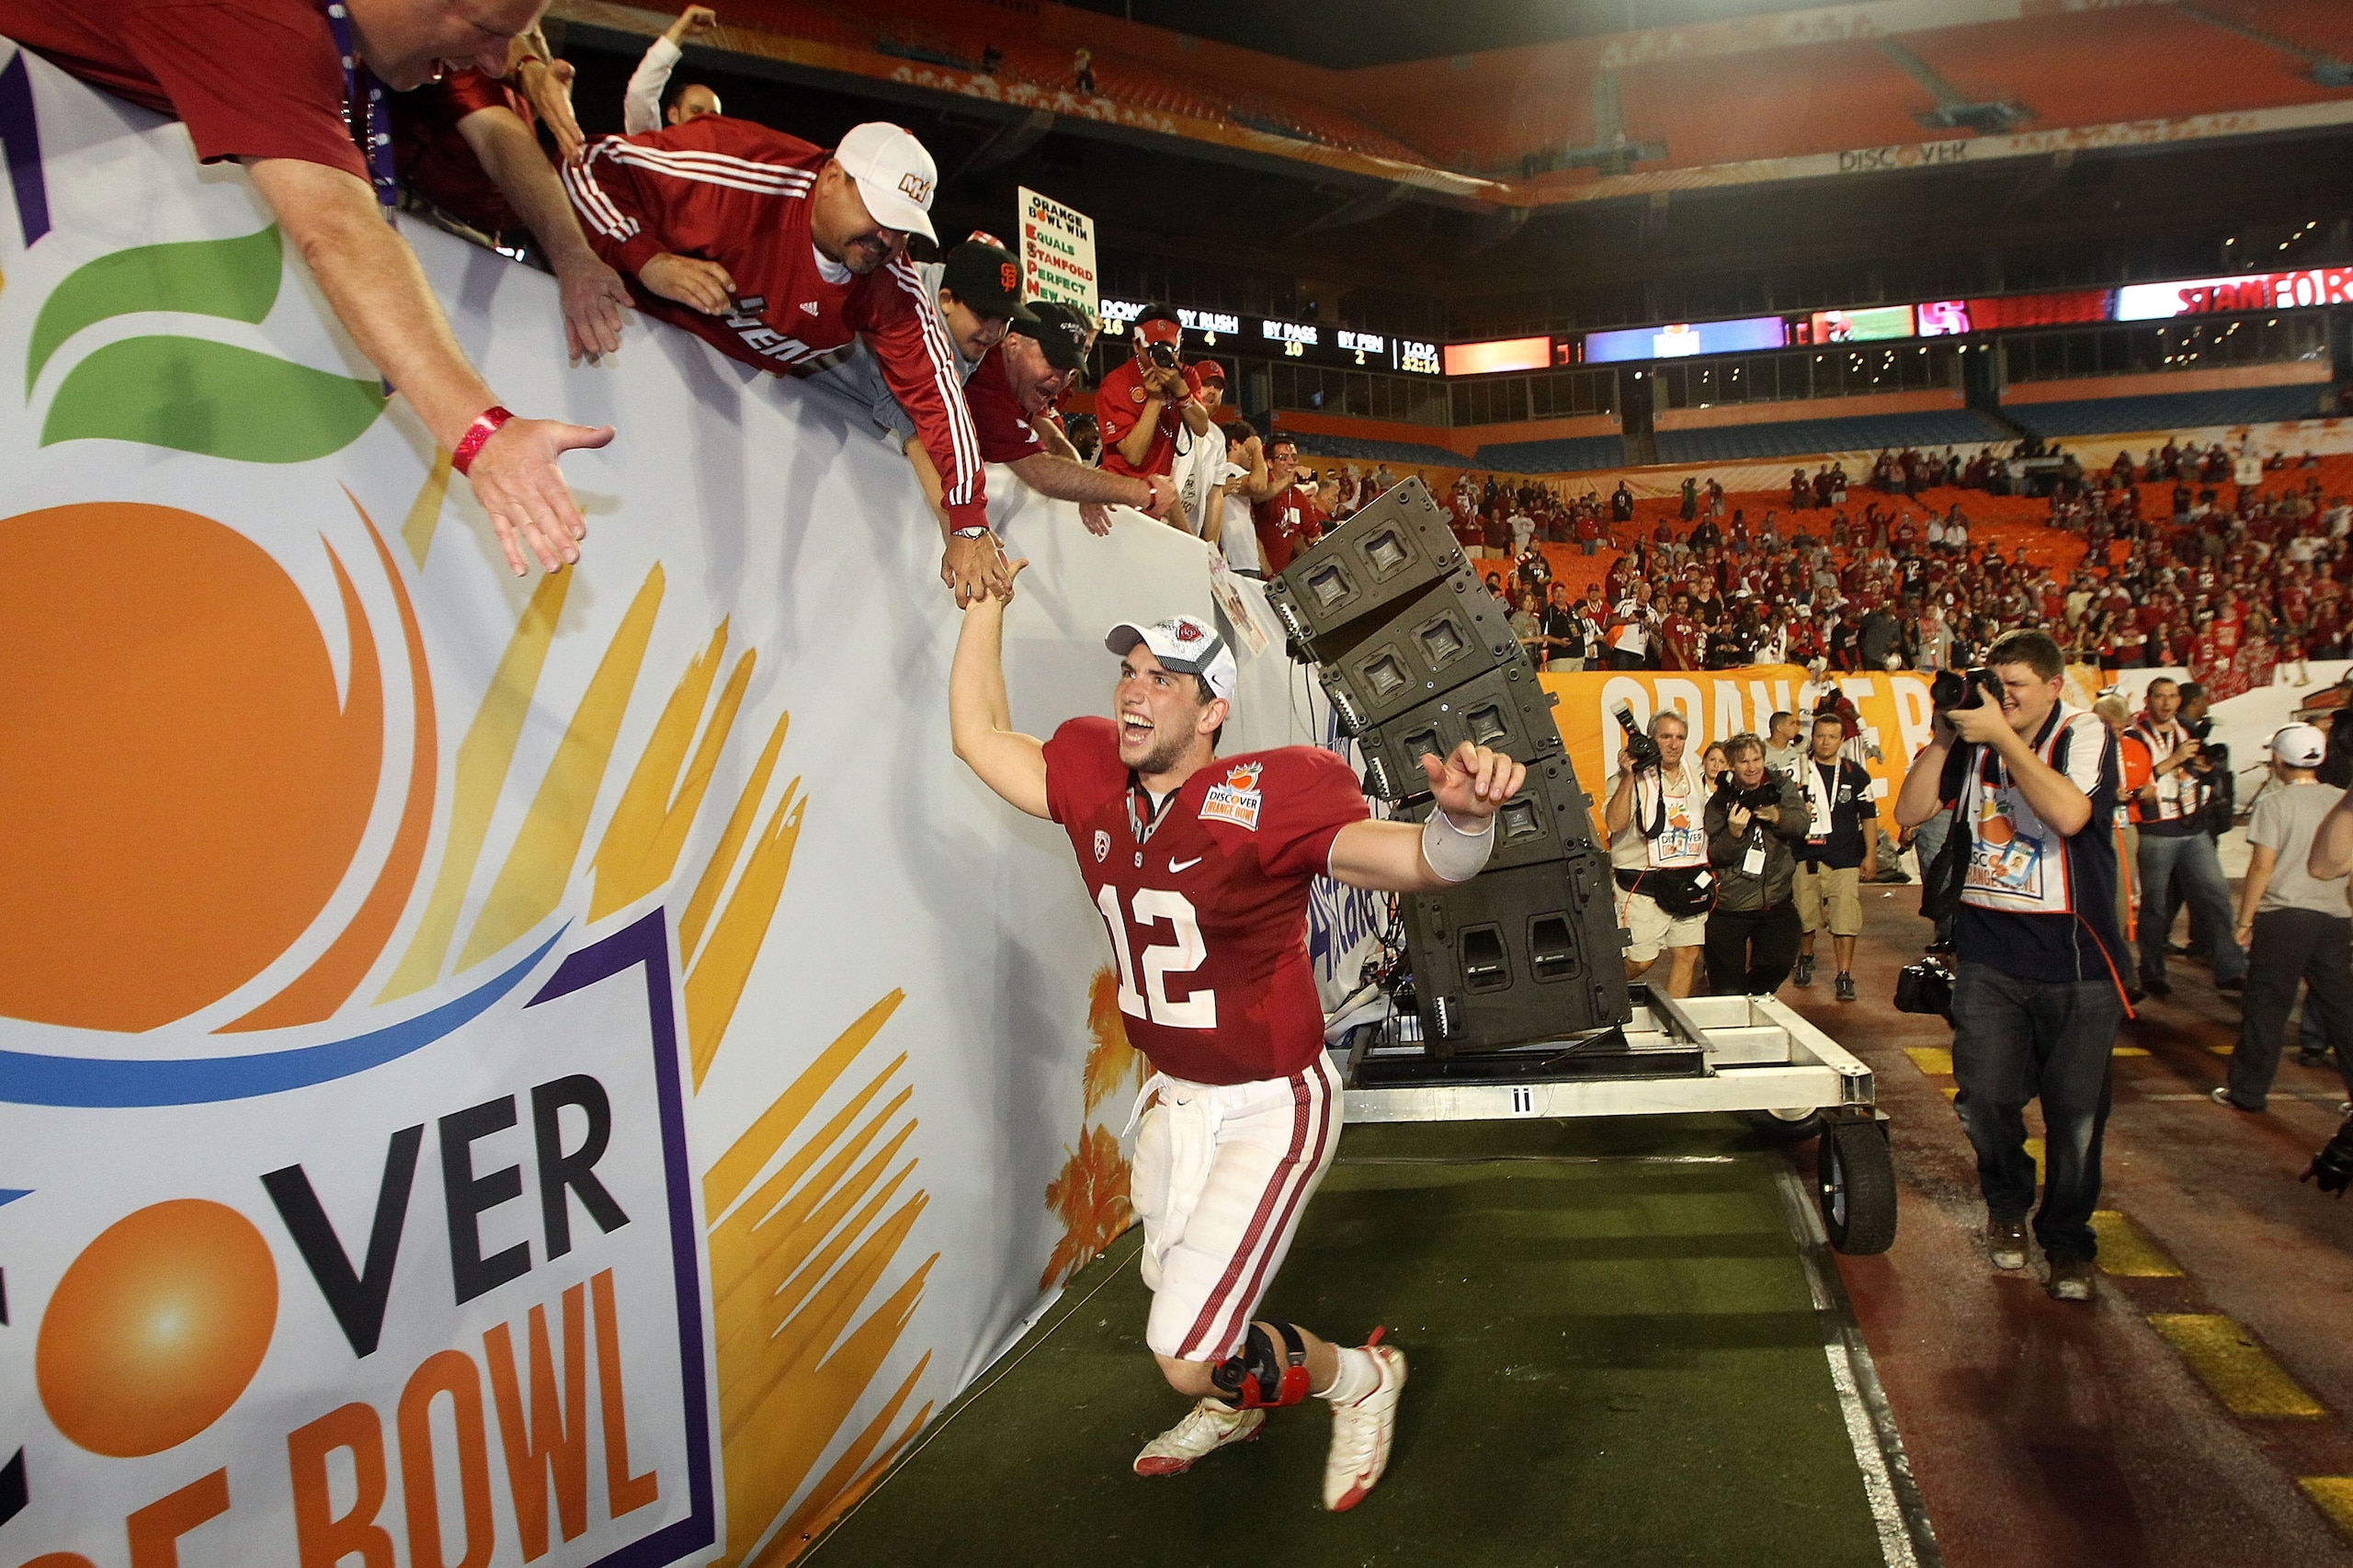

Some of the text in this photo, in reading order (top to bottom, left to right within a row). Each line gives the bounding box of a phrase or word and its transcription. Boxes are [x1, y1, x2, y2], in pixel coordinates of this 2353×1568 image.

[1029, 206, 1087, 241] BOWL WIN
[1032, 197, 1083, 227] ORANGE
[1025, 223, 1075, 256] EQUALS
[1026, 242, 1093, 281] STANFORD
[1027, 259, 1086, 295] PERFECT
[1027, 278, 1096, 317] NEW YEAR
[1100, 300, 1147, 319] DOW
[1199, 312, 1239, 332] RUSH
[1263, 320, 1282, 337] BY
[1284, 324, 1317, 342] PASS
[1337, 330, 1356, 346] BY
[1358, 333, 1384, 351] PEN
[1103, 318, 1124, 335] 16
[1204, 331, 1217, 346] 4
[1284, 341, 1303, 357] 10
[1355, 350, 1365, 365] 2
[1402, 357, 1440, 375] 32:14
[1204, 801, 1255, 824] ORANGE BOWL
[1210, 791, 1257, 810] DISCOVER
[1097, 883, 1217, 1028] 12
[287, 1267, 658, 1568] BOWL
